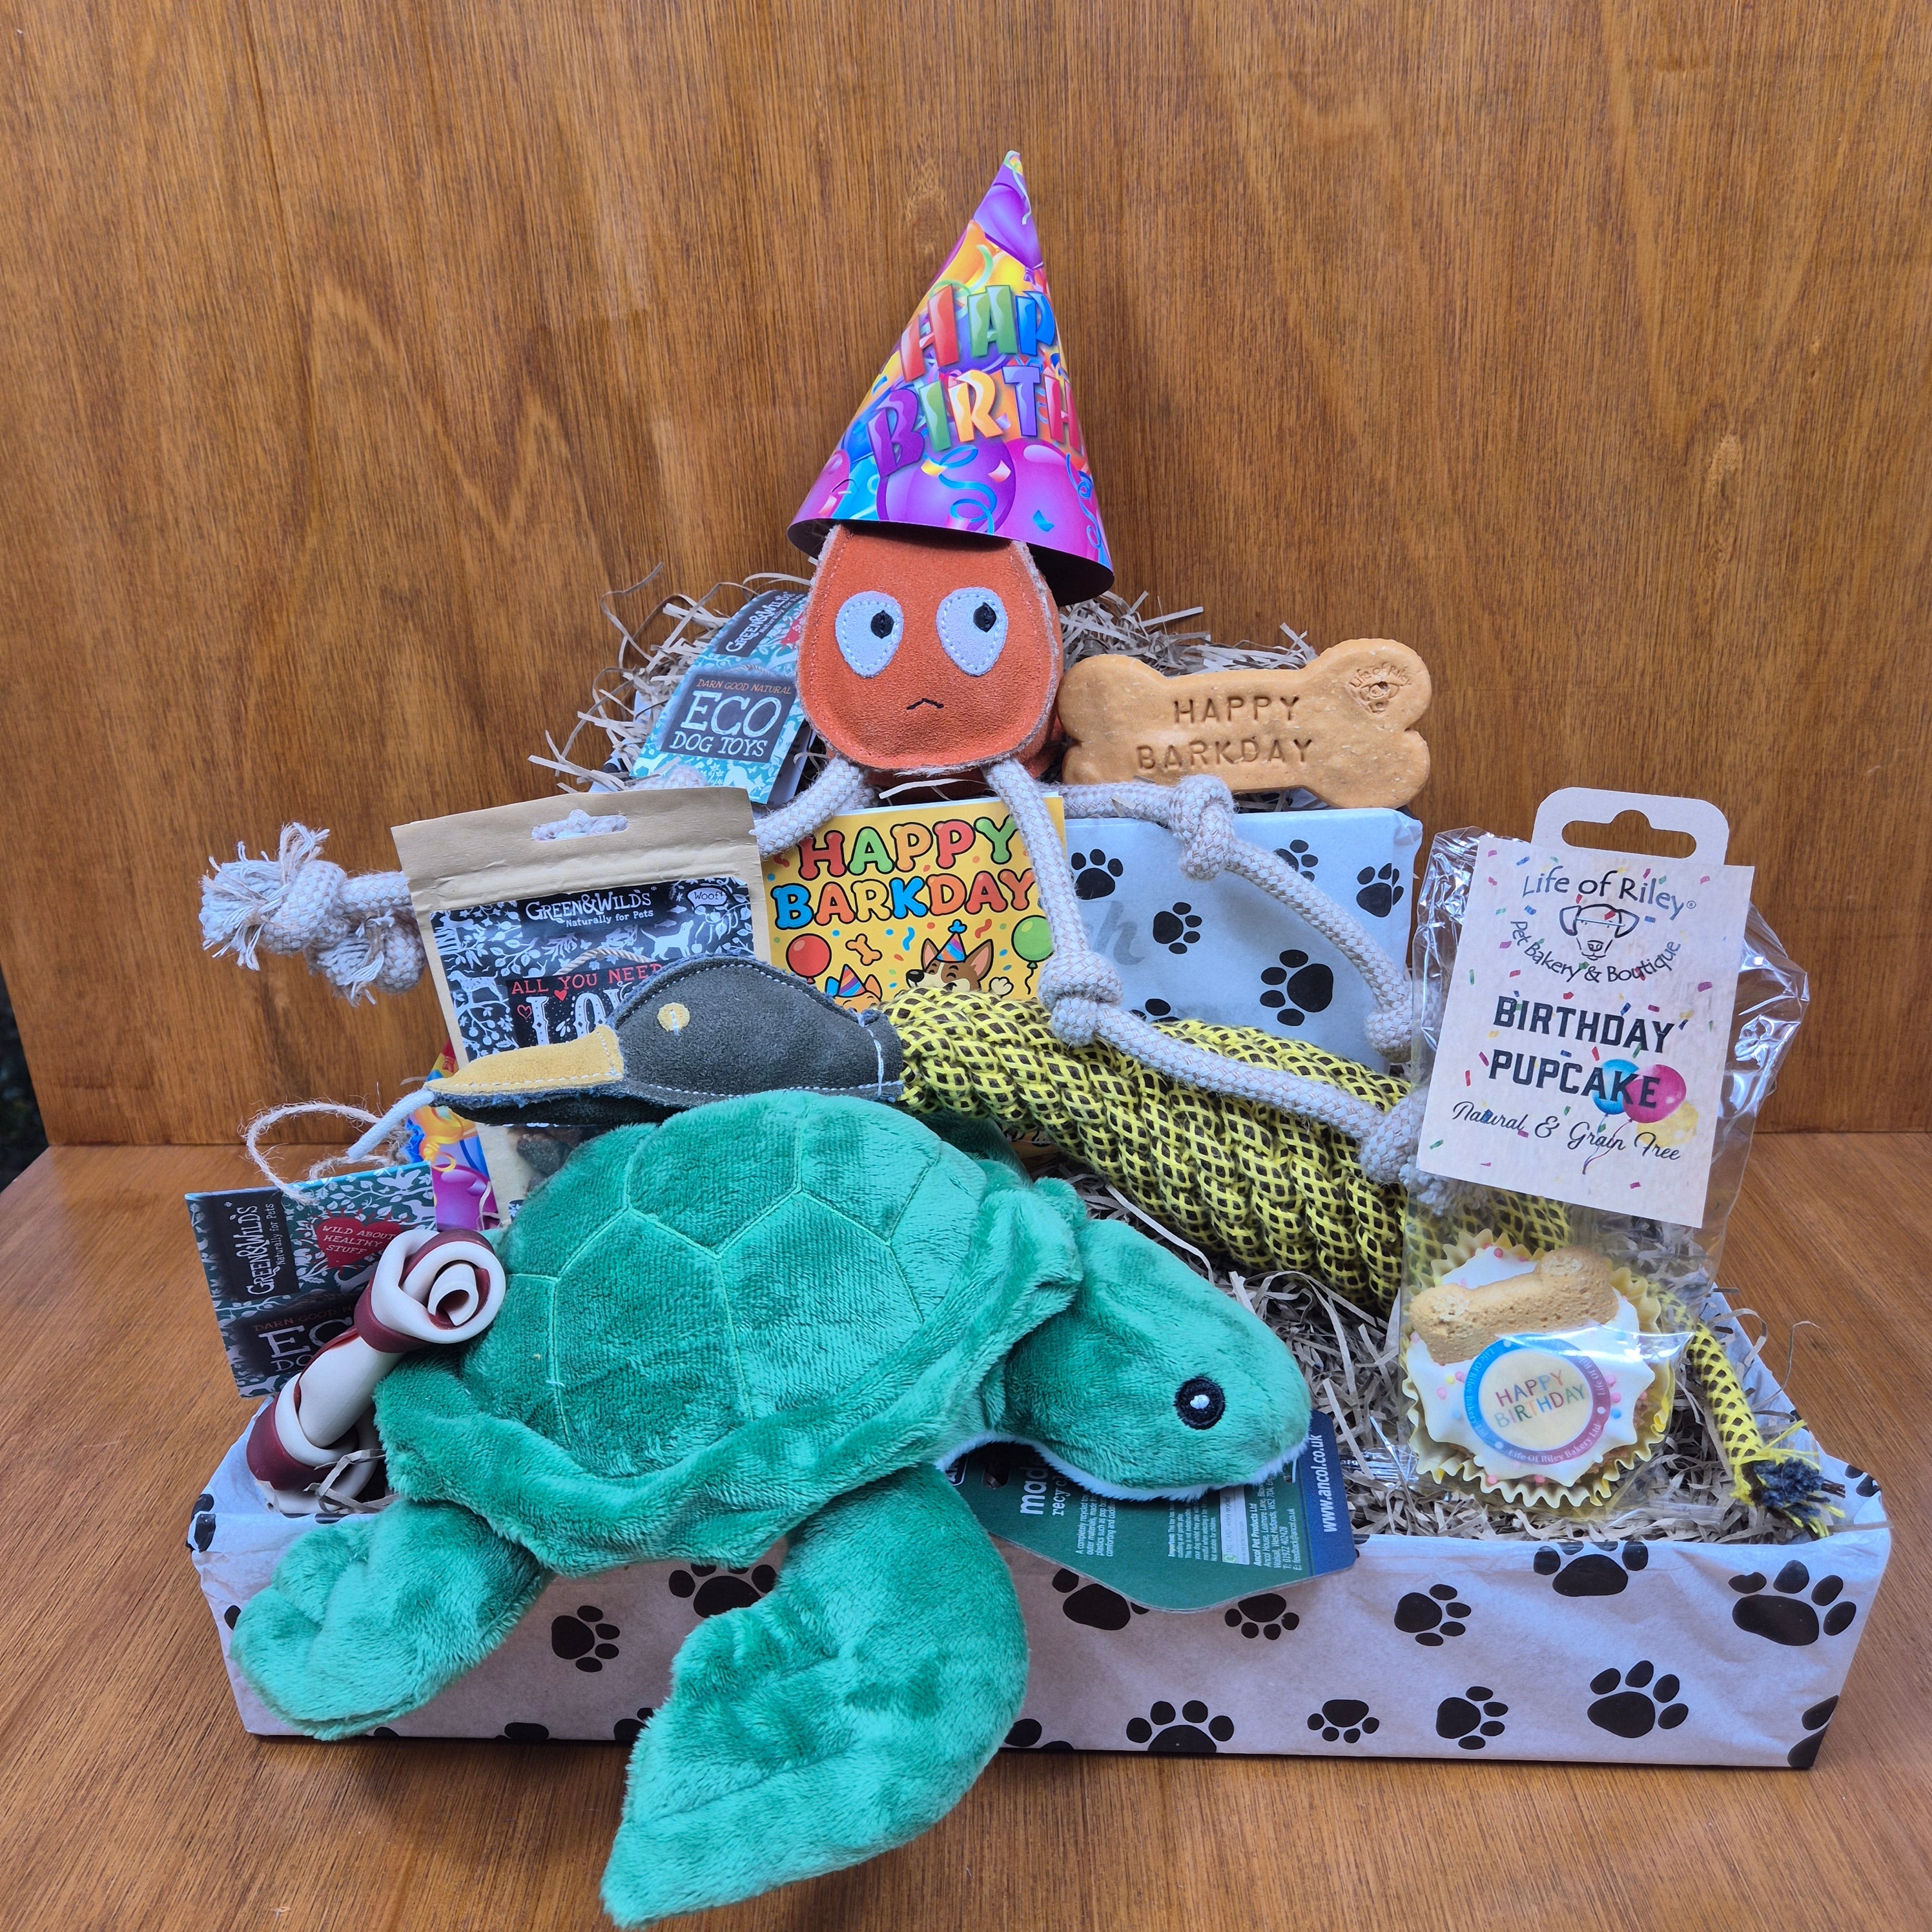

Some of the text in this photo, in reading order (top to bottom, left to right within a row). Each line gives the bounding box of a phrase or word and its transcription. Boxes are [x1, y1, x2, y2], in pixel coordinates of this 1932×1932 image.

[695, 679, 792, 695] DARN GOOD NATURAL
[680, 690, 782, 737] ECO
[1172, 695, 1300, 724] HAPPY
[669, 731, 714, 753] DOG
[717, 736, 768, 757] TOYS
[1135, 737, 1313, 770] BARKDAY
[797, 814, 1019, 880] HAPPY
[1522, 865, 1570, 898] Life
[1578, 870, 1618, 896] of
[770, 868, 1036, 929] BARKDAY
[566, 909, 653, 928] Naturally for Pets
[1510, 921, 1681, 983] Pet Bakery & Boutique
[511, 963, 664, 995] ALL YOU NEED
[1493, 995, 1675, 1054] BIRTHDAY
[1488, 1049, 1661, 1109] PUPCAKE
[1452, 1101, 1681, 1161] Natural & Grain Free
[265, 1203, 286, 1265] Naturally for Pets
[322, 1226, 396, 1240] WILD ABOUT
[323, 1235, 382, 1248] HEALTHY
[326, 1244, 367, 1254] STUFF
[253, 1310, 336, 1331] DARN GOOD
[258, 1317, 353, 1358] EC
[271, 1354, 313, 1372] DO
[1495, 1370, 1563, 1407] HAPPY
[1494, 1384, 1585, 1428] BIRTHDAY
[1541, 1454, 1563, 1464] Riley
[1565, 1439, 1594, 1458] Bakery
[1588, 1423, 1601, 1438] Ltd
[1308, 1434, 1337, 1532] www.ancol.co.uk
[1080, 1503, 1089, 1521] recycled
[1260, 1512, 1268, 1533] Leamore
[1077, 1523, 1089, 1549] completely
[1095, 1537, 1104, 1556] plastics
[1105, 1530, 1116, 1556] comforting
[1249, 1503, 1262, 1566] Ancol Pet Products Ltd
[1262, 1534, 1271, 1551] House,
[1279, 1526, 1288, 1545] 402428
[1263, 1552, 1271, 1567] Ancol
[1272, 1549, 1282, 1568] Walsall,
[1281, 1547, 1291, 1563] 01922
